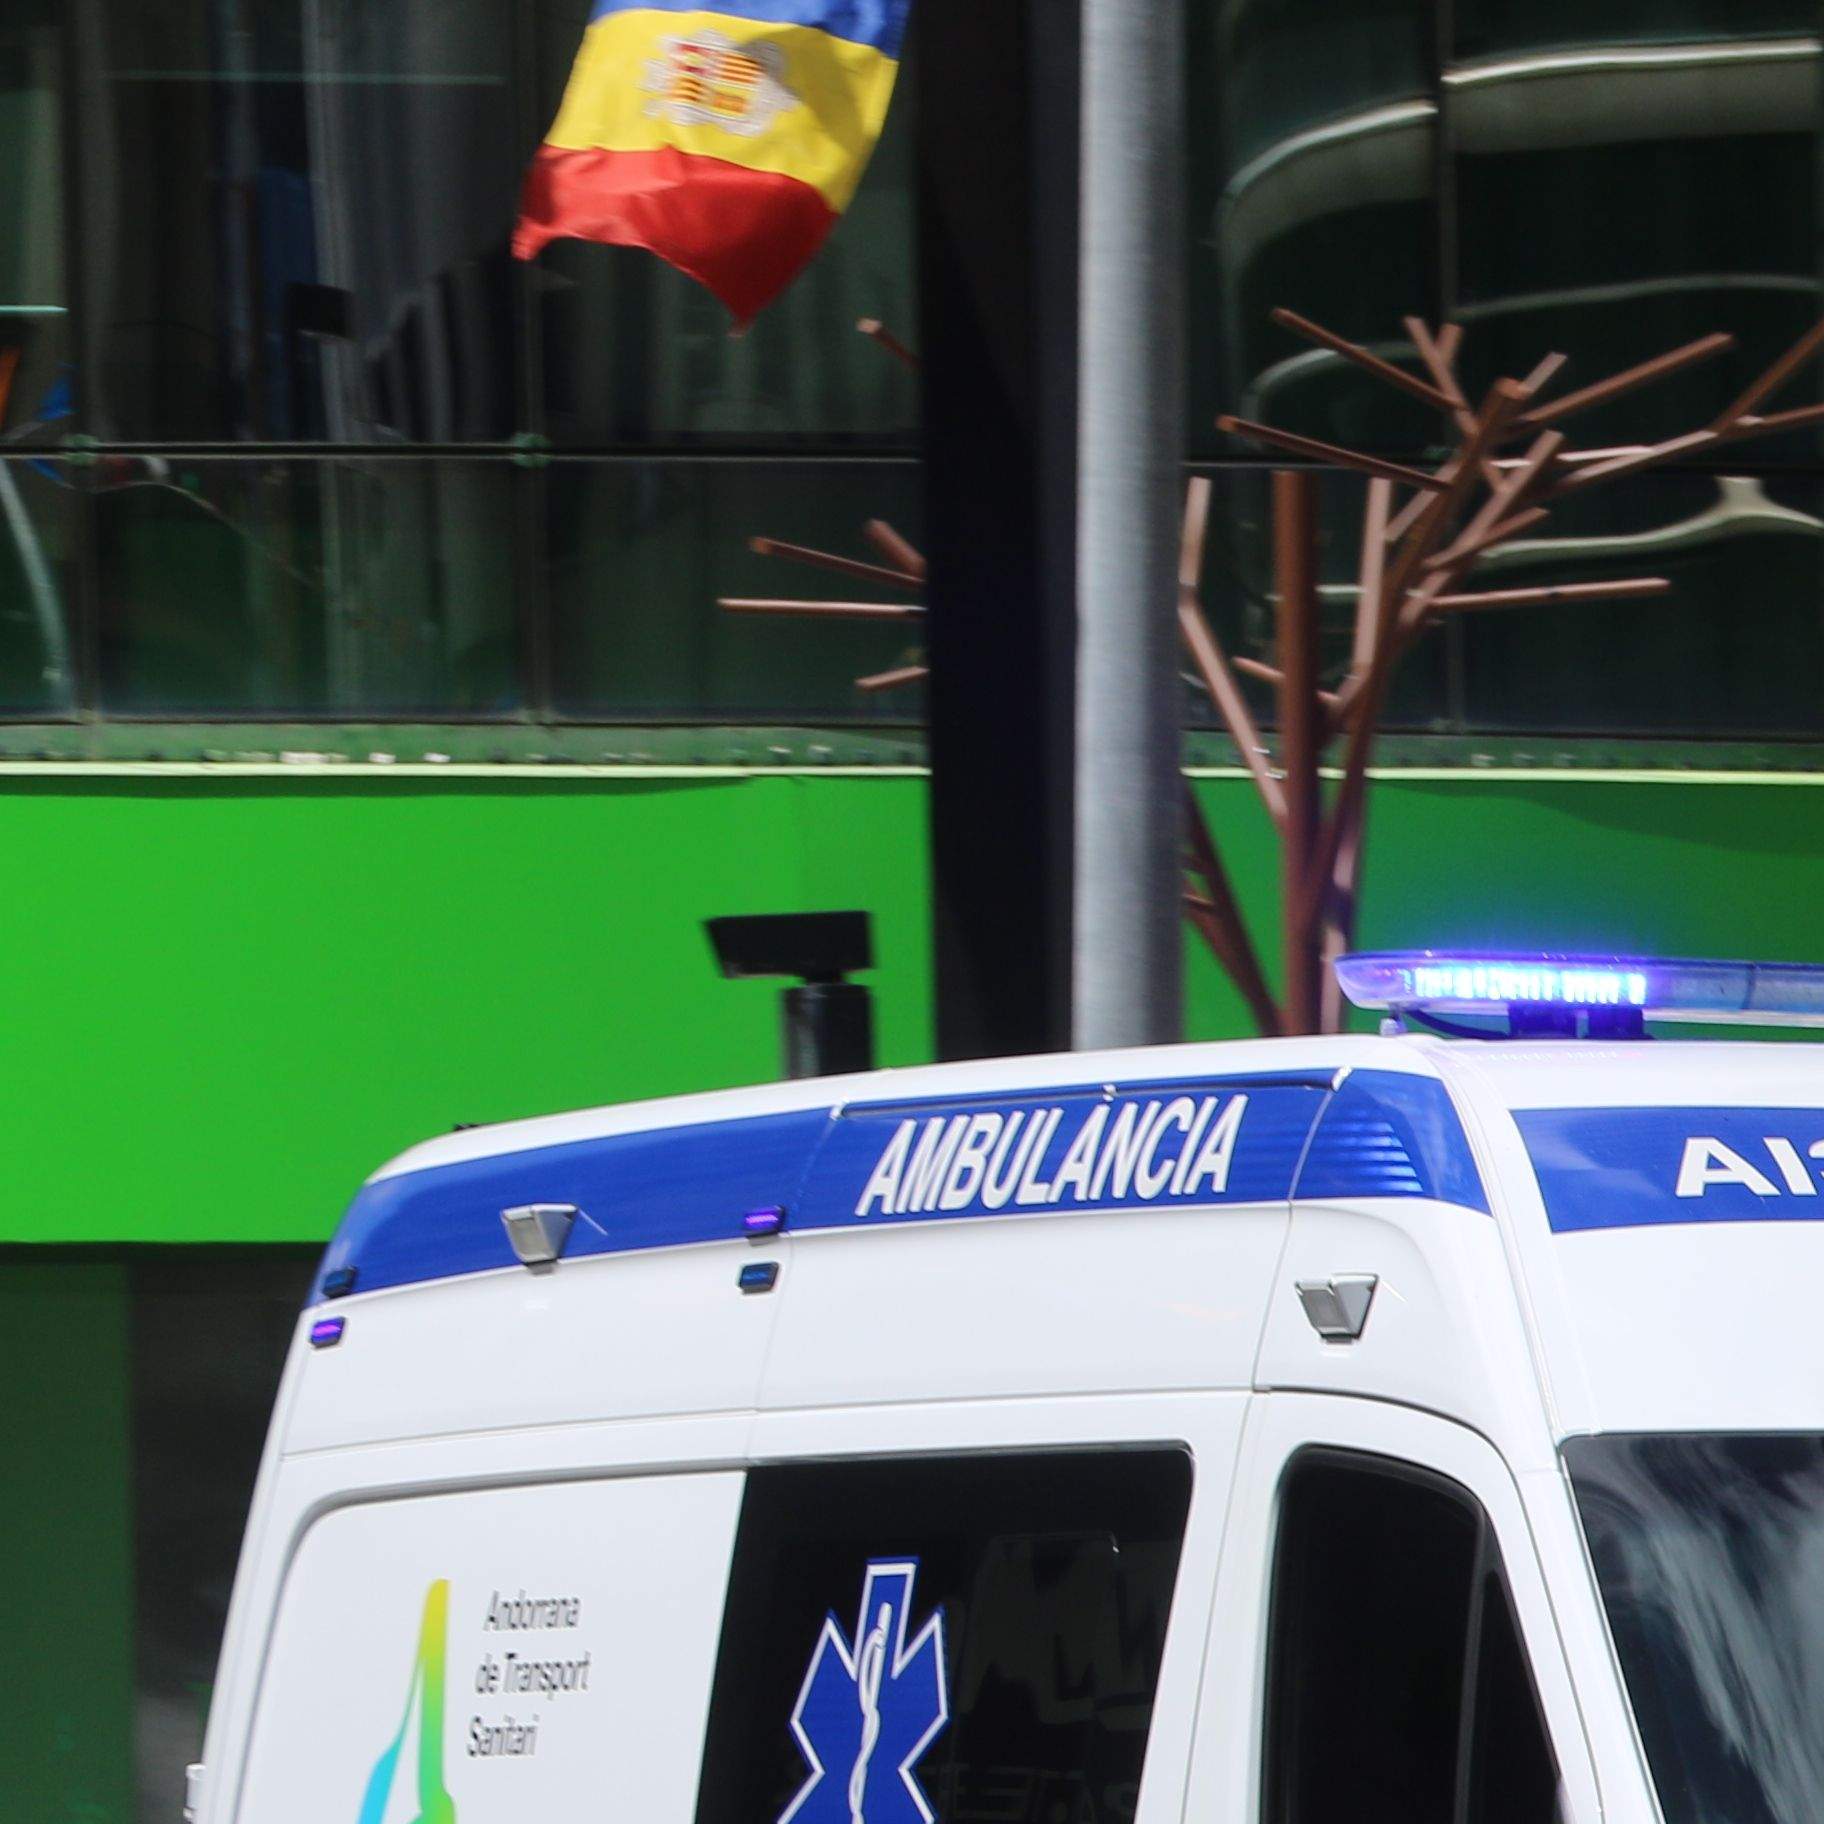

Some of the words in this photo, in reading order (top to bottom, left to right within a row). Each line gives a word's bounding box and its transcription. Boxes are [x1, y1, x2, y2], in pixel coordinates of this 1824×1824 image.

[483, 1589, 580, 1631] Andorrana
[475, 1653, 498, 1694] de
[503, 1651, 591, 1700] Transport
[467, 1713, 540, 1757] Sanitari
